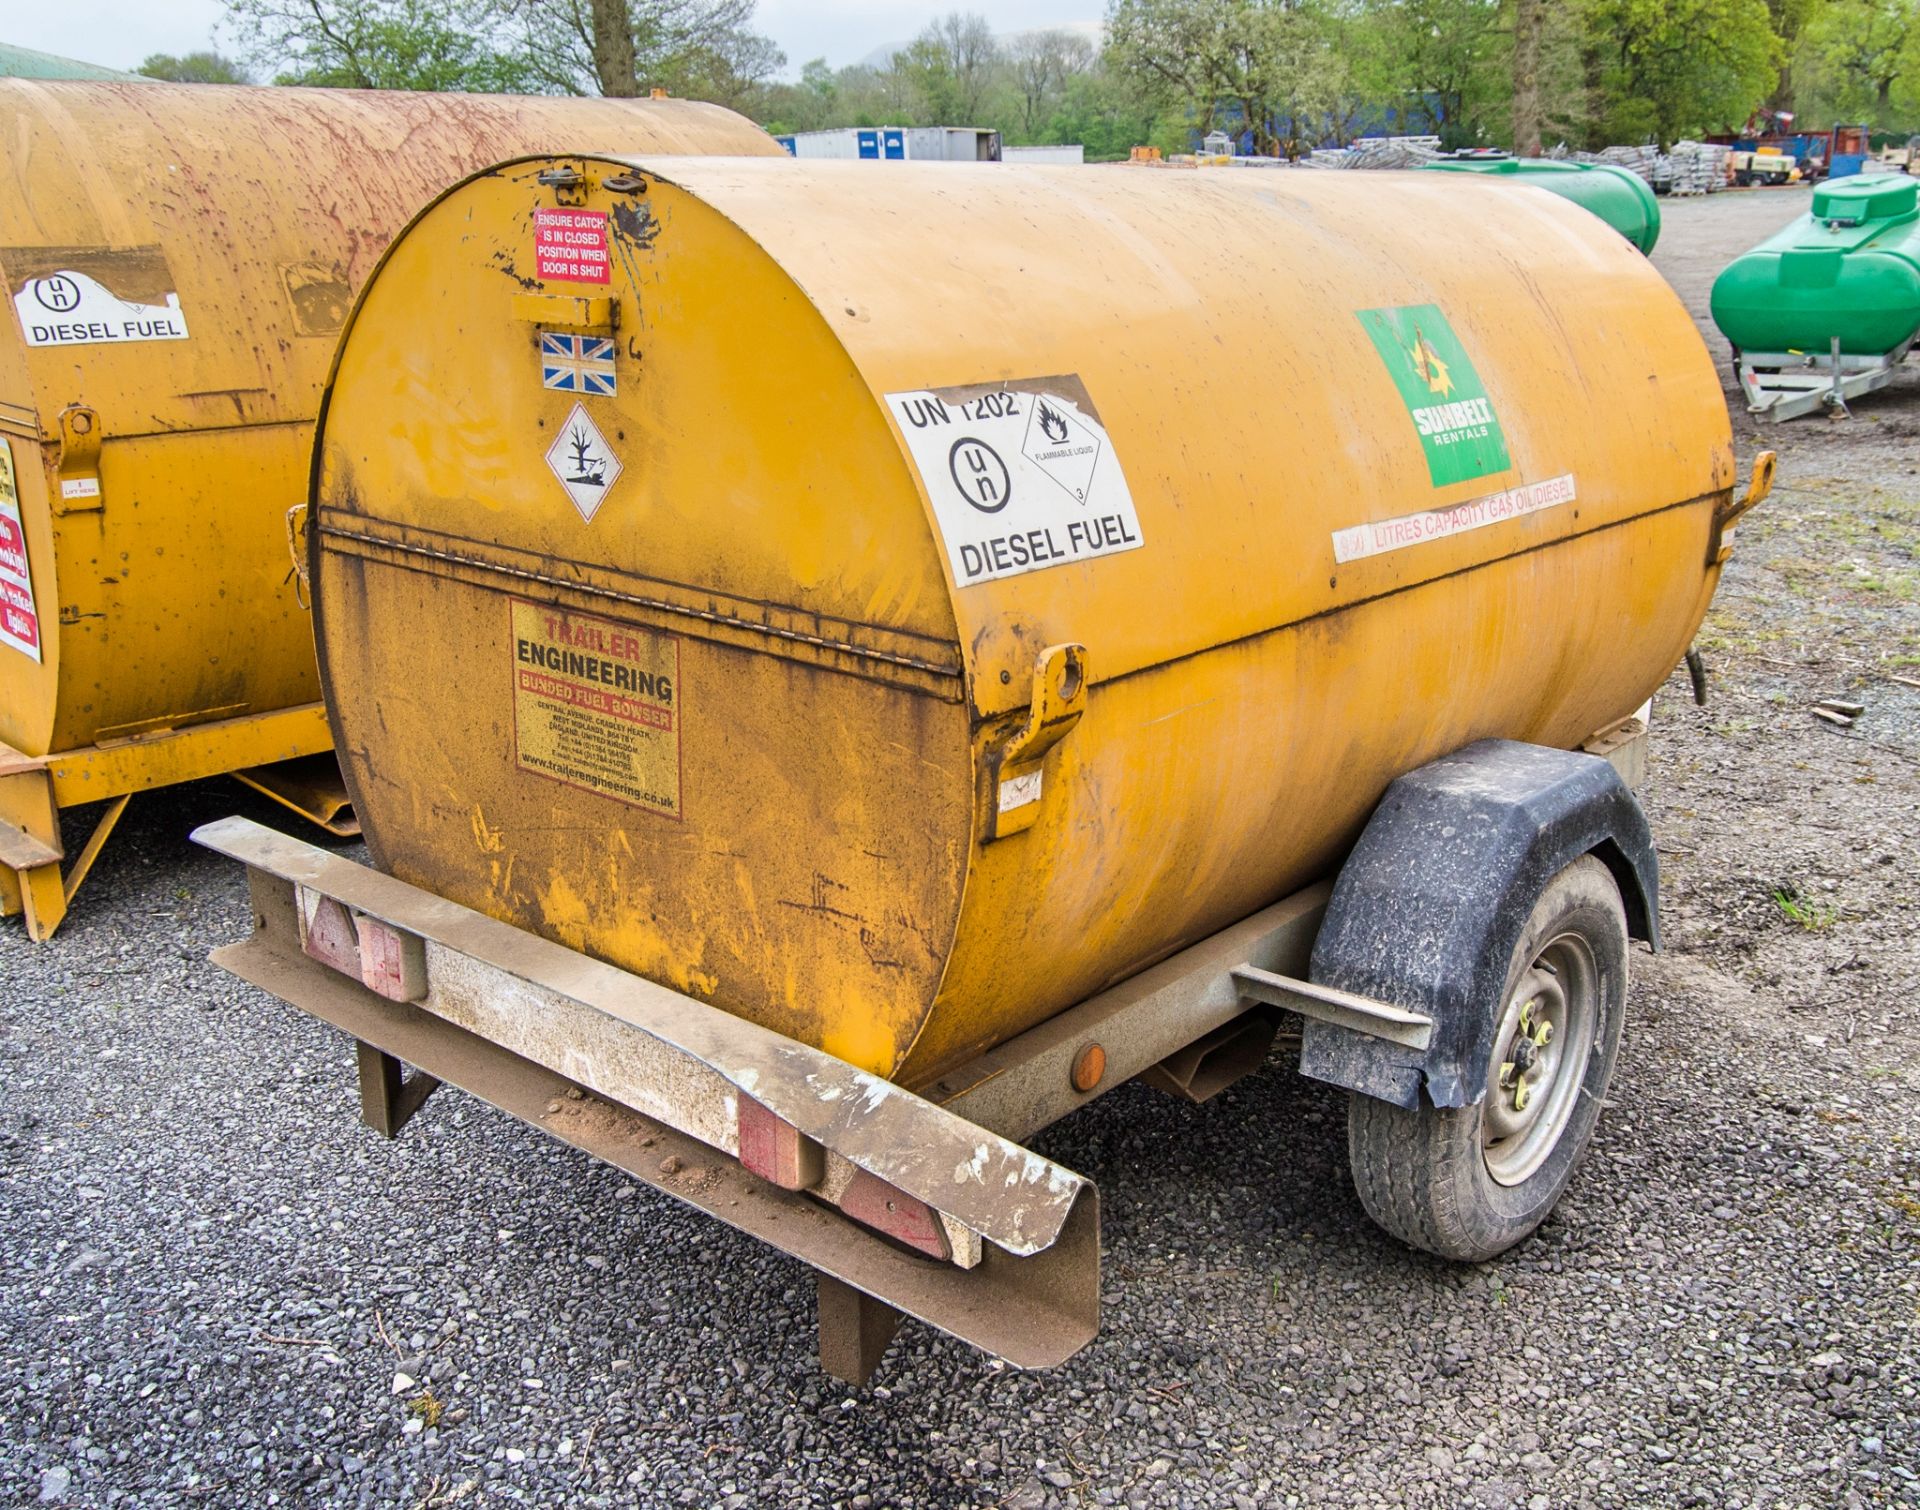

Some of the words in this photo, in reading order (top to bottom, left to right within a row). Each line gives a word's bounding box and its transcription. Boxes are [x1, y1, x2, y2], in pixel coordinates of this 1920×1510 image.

[538, 214, 573, 227] ENSURE
[574, 216, 604, 229] CATCH
[543, 230, 552, 241] IS
[554, 231, 563, 242] IN
[564, 232, 600, 246] CLOSED
[538, 246, 578, 260] POSITION
[580, 249, 607, 262] WHEN
[542, 262, 568, 274] DOOR
[570, 264, 579, 276] IS
[580, 264, 604, 278] SHUT
[32, 323, 118, 342] DIESEL
[123, 320, 181, 338] FUEL
[901, 397, 952, 428] UN
[960, 391, 1020, 421] 1202
[1412, 397, 1492, 436] SUNBELT
[1433, 426, 1488, 446] RENTALS
[1035, 449, 1072, 461] FLAMMABLE
[1074, 446, 1094, 454] LIQUID
[1076, 488, 1084, 500] 3
[1374, 518, 1422, 548] LITRES
[1425, 502, 1486, 534] CAPACITY
[1488, 494, 1513, 518] GAS
[960, 528, 1066, 578] DIESEL
[1068, 514, 1136, 554] FUEL
[544, 616, 641, 662] TRAILER
[517, 638, 672, 702] ENGINEERING
[522, 673, 572, 700] BUNDED
[575, 689, 608, 710] FUEL
[612, 700, 670, 728] BOWSER
[538, 700, 566, 715] CENTRAL
[553, 714, 569, 724] WEST
[522, 753, 674, 809] www.trailerengineering.co.uk
